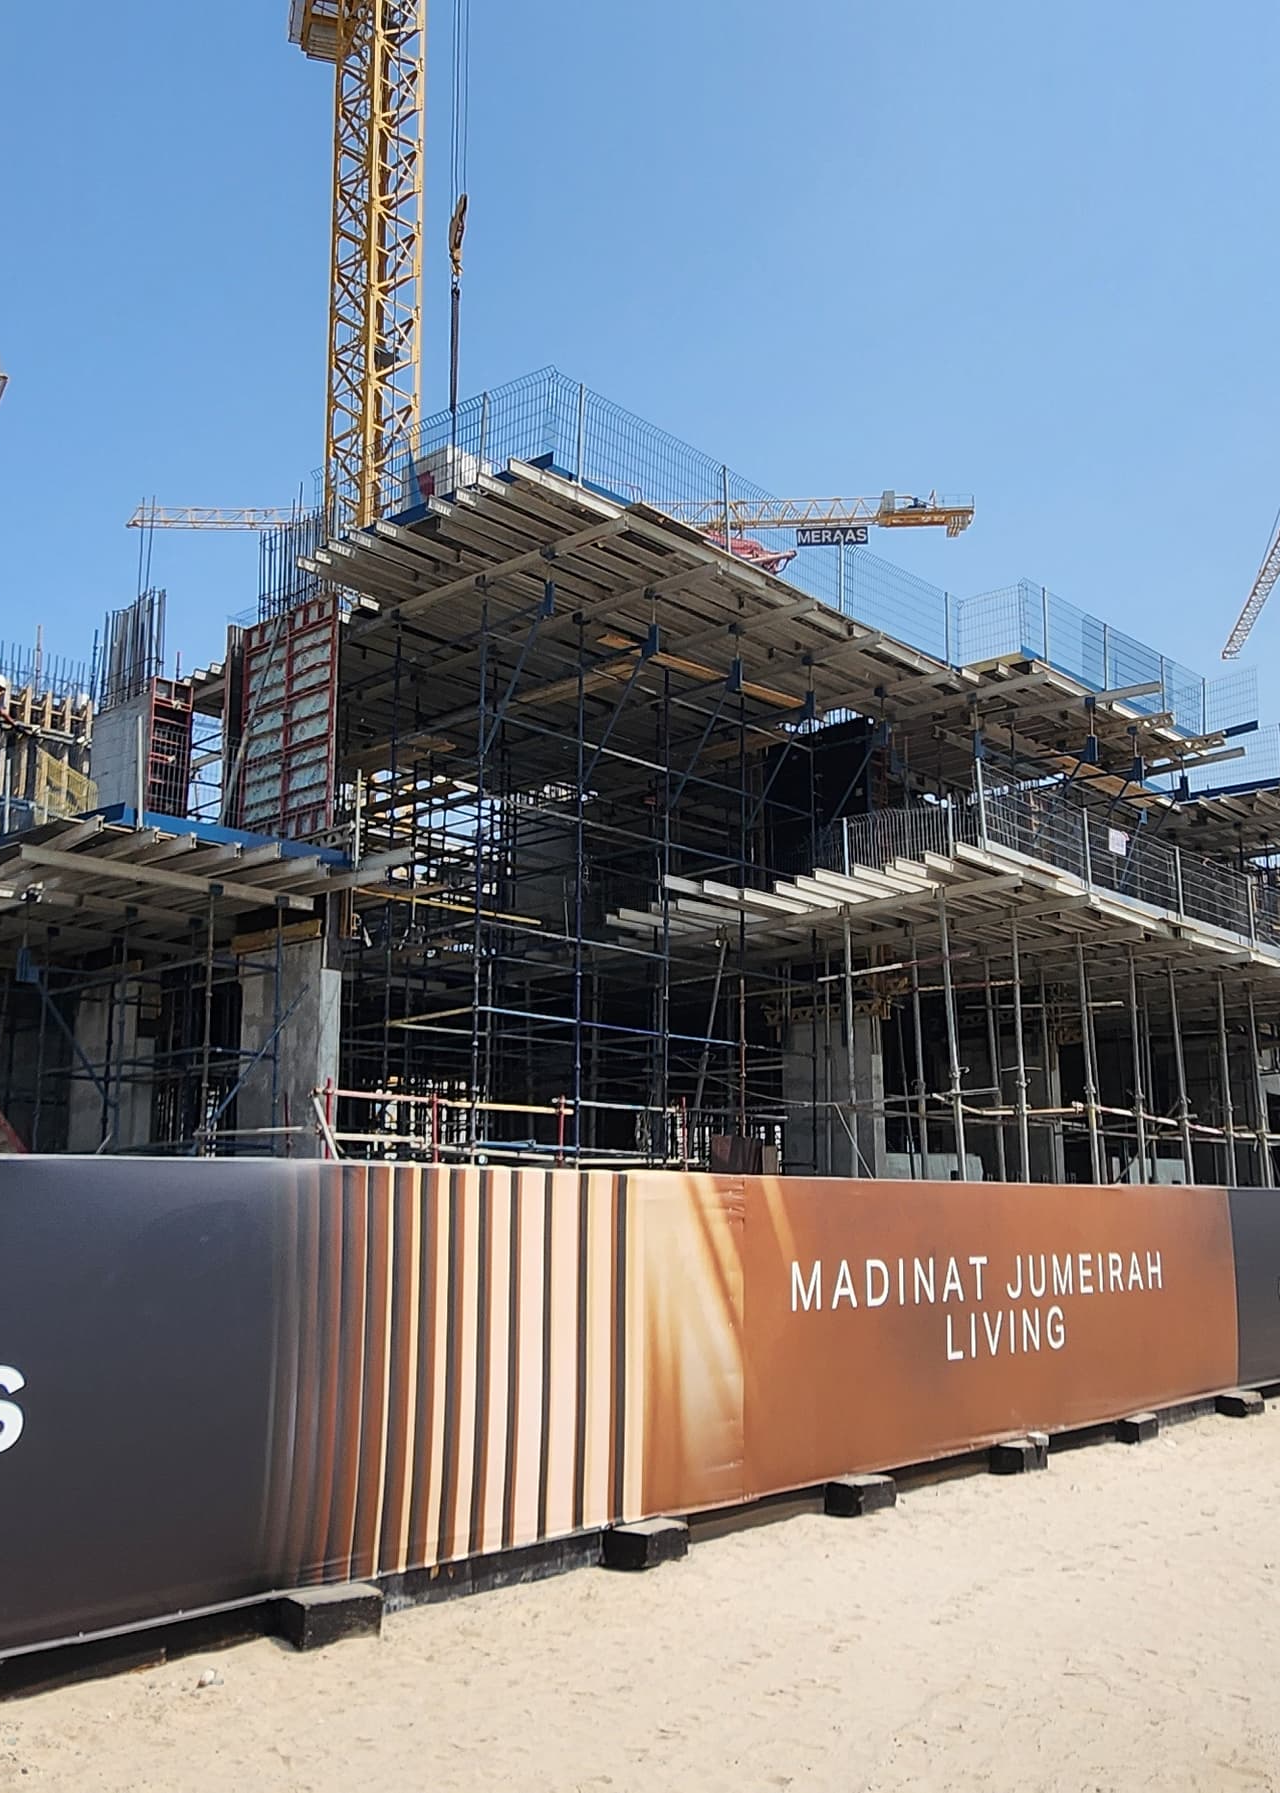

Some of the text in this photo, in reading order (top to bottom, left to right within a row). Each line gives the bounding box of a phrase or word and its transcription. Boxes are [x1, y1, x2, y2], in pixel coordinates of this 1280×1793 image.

[797, 528, 867, 544] MERAAS
[791, 1250, 1163, 1312] MADINAT JUMEIRAH
[946, 1306, 1066, 1361] LIVING
